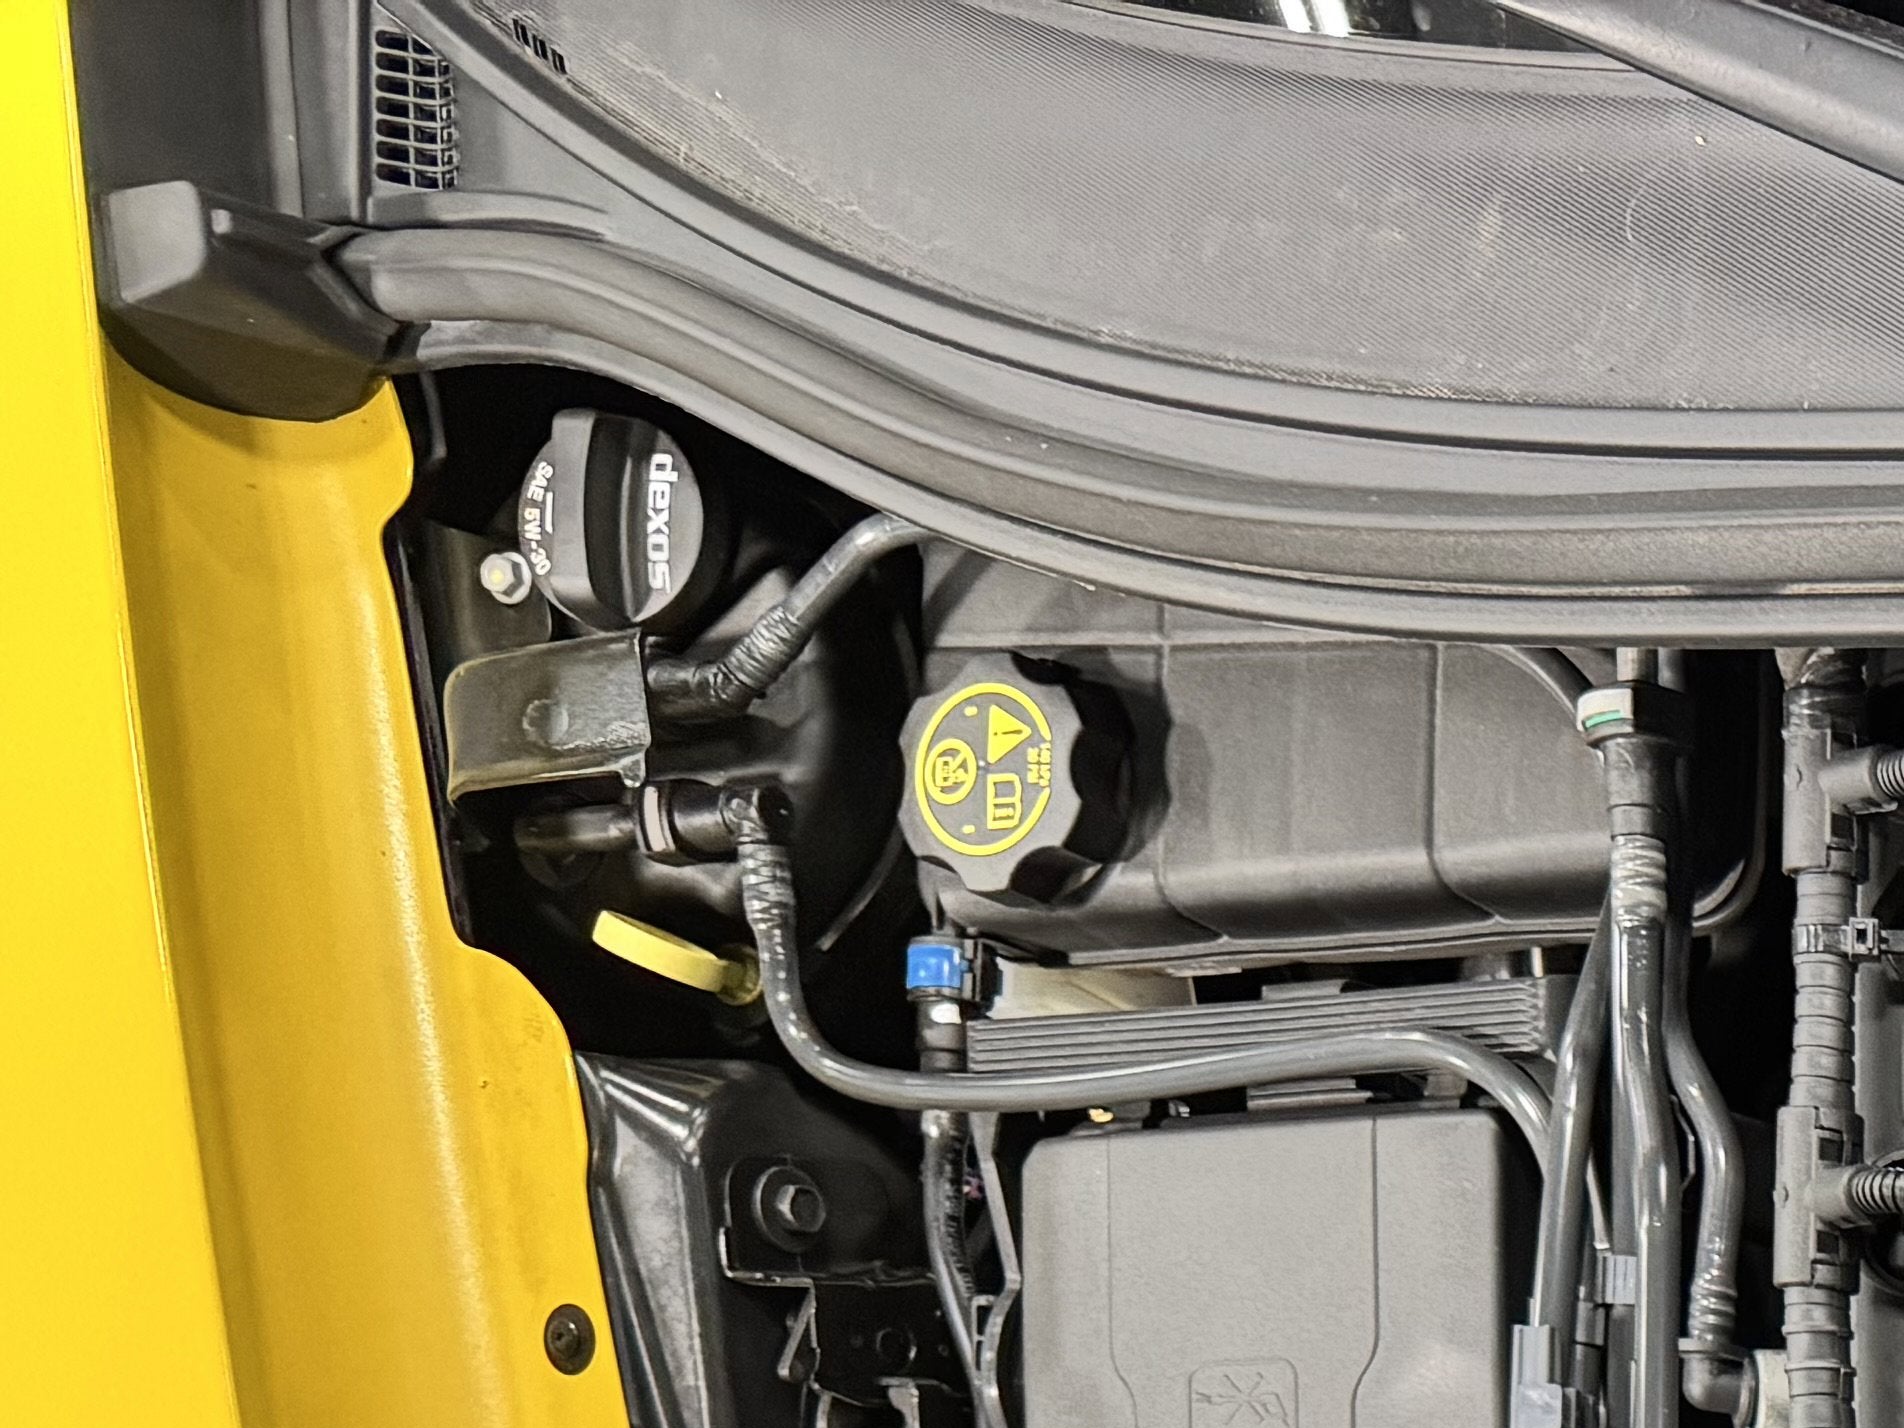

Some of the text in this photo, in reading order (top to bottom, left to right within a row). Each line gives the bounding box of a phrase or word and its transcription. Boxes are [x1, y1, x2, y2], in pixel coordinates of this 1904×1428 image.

[523, 461, 554, 576] SAE 5W-30
[647, 453, 679, 593] dexos
